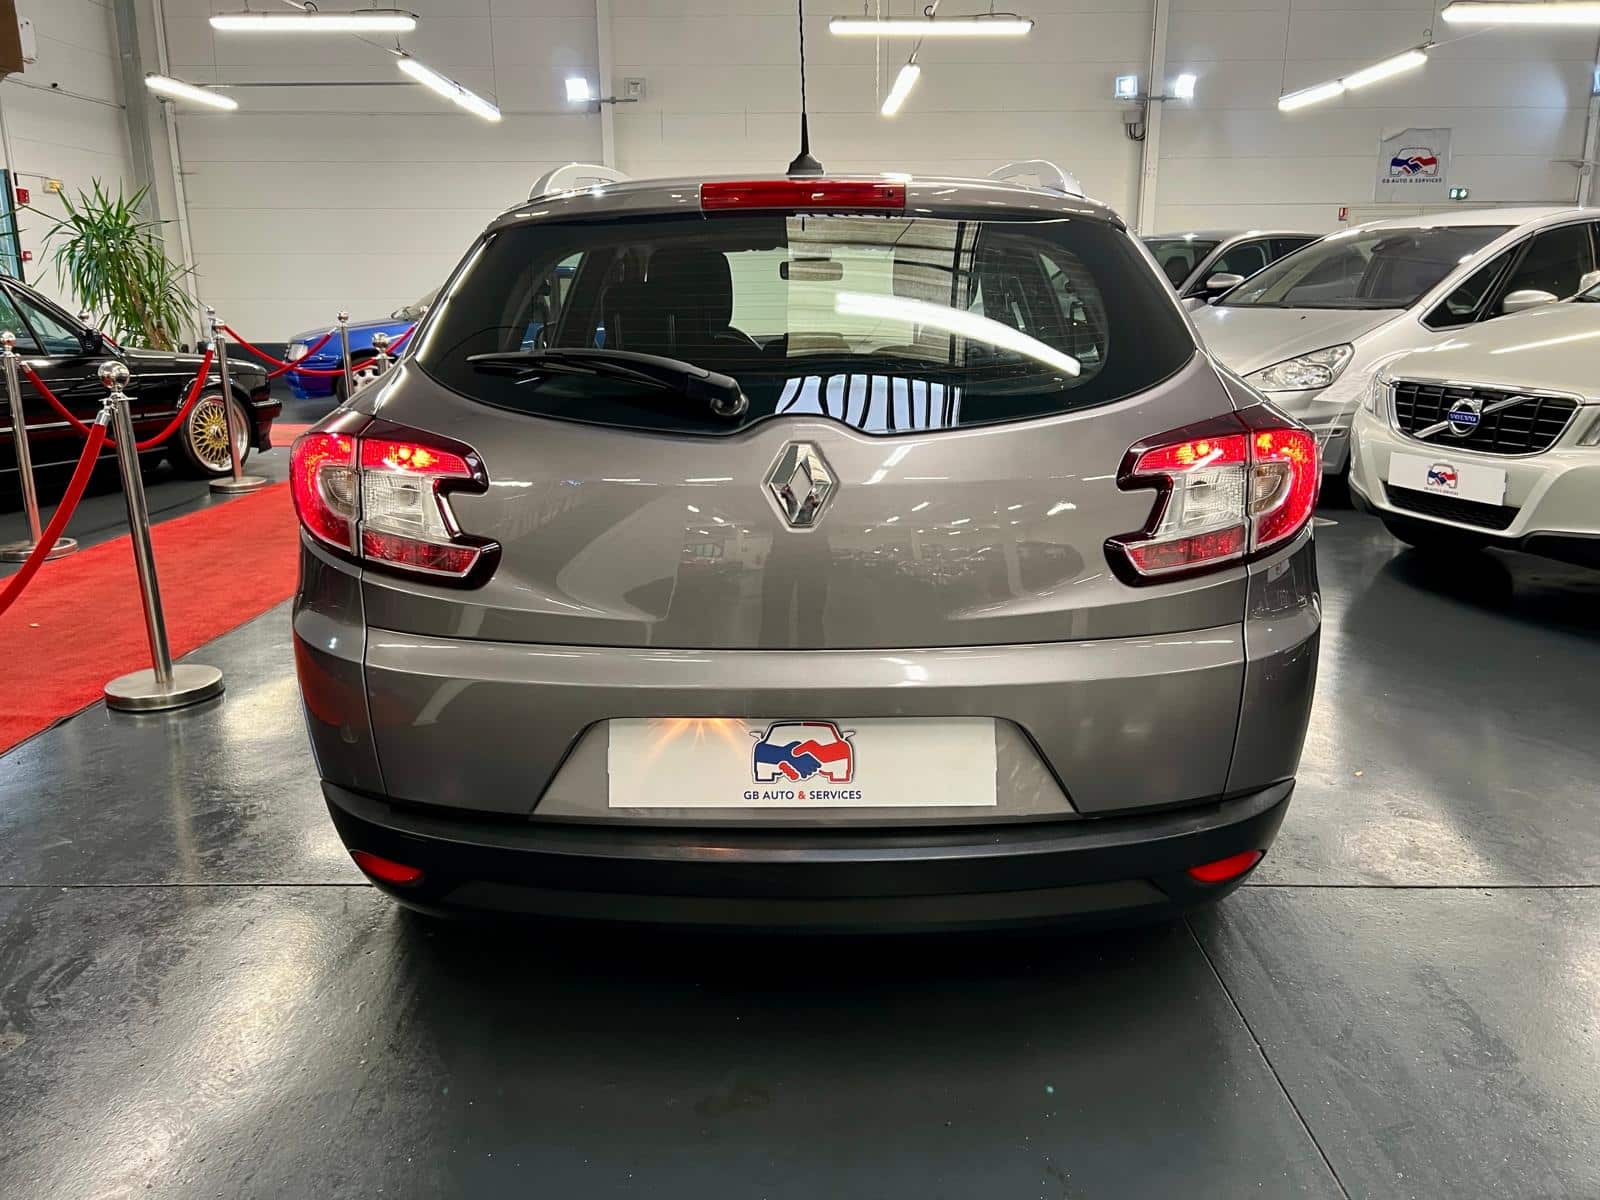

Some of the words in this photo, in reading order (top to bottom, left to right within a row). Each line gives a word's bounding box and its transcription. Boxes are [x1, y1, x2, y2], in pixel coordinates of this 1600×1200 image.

[1450, 413, 1477, 422] VOLVO
[743, 790, 760, 800] GB
[762, 790, 795, 800] AUTO
[797, 790, 806, 800] &
[809, 790, 862, 800] SERVICES
